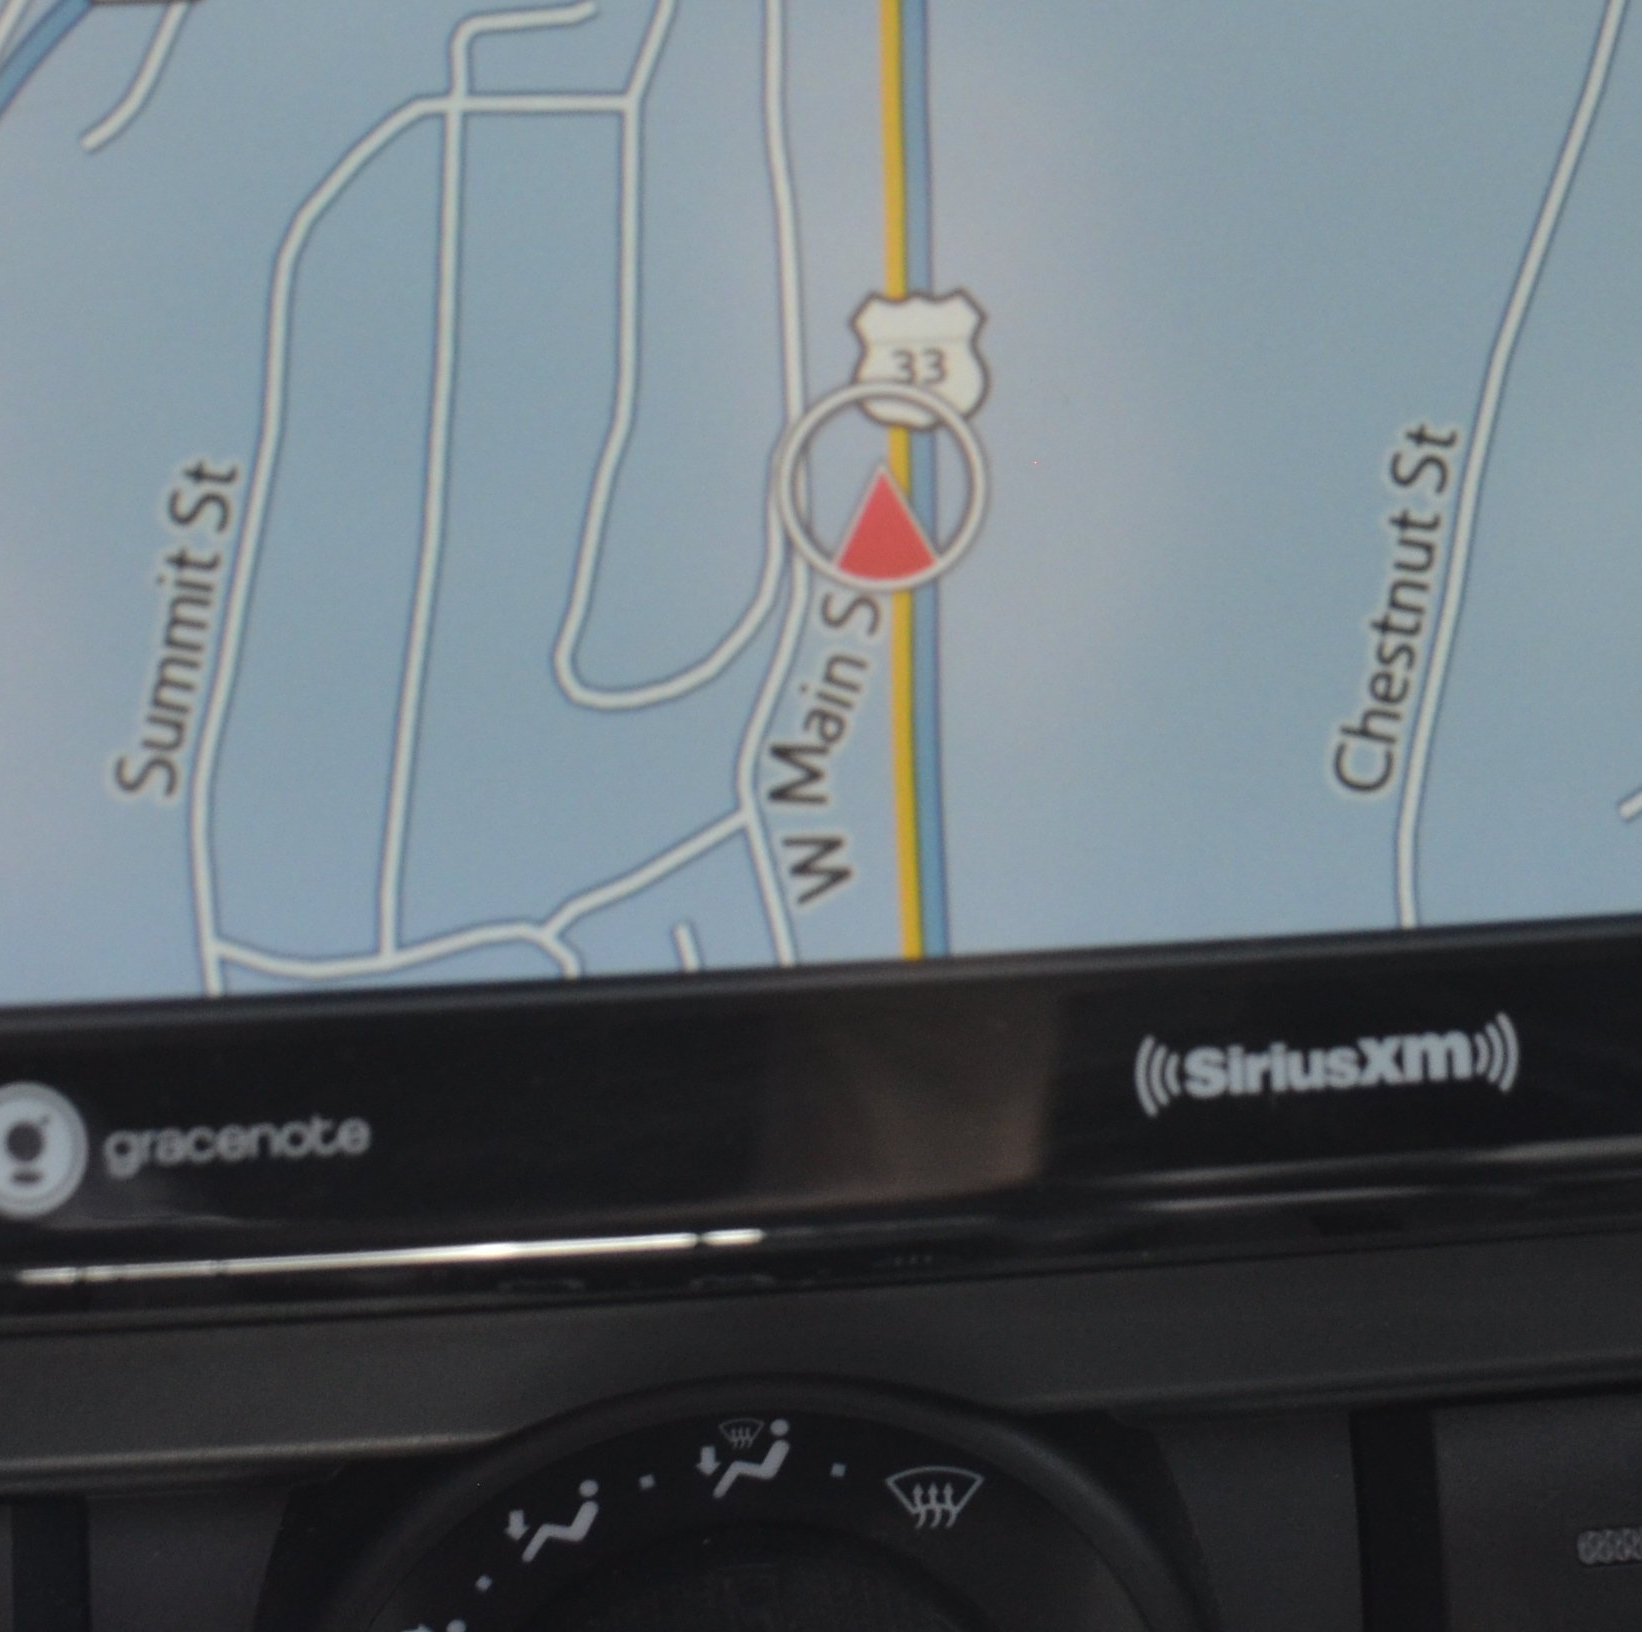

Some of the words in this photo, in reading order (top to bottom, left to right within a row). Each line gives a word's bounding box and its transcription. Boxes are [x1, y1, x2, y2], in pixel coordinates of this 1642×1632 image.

[890, 349, 948, 384] 33
[167, 459, 238, 533] St
[820, 592, 882, 636] S
[1333, 508, 1442, 794] Chestnut
[1390, 423, 1457, 495] St
[114, 545, 222, 799] Summit
[767, 652, 869, 806] Main
[782, 835, 853, 904] W
[103, 1113, 372, 1180] gracenote
